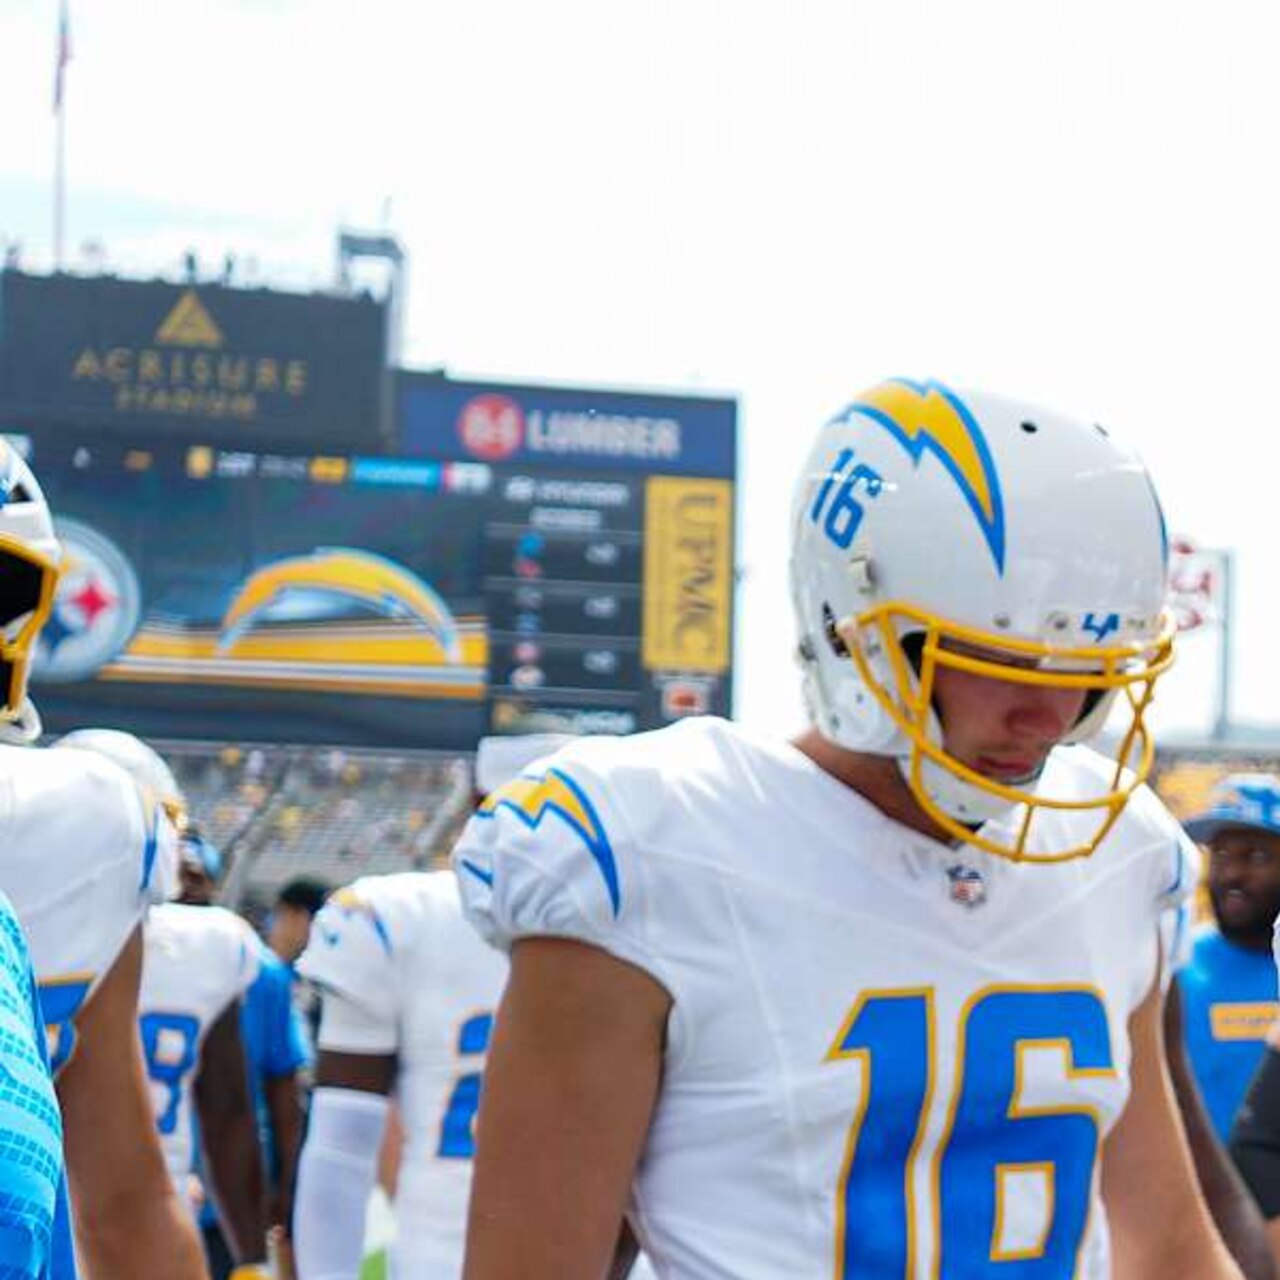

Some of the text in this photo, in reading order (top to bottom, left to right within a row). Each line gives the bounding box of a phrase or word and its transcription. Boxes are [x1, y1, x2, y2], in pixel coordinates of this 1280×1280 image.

[72, 349, 307, 395] ACRISURE
[527, 409, 682, 458] LUMBER
[812, 447, 882, 550] 16
[673, 493, 719, 656] UPMC
